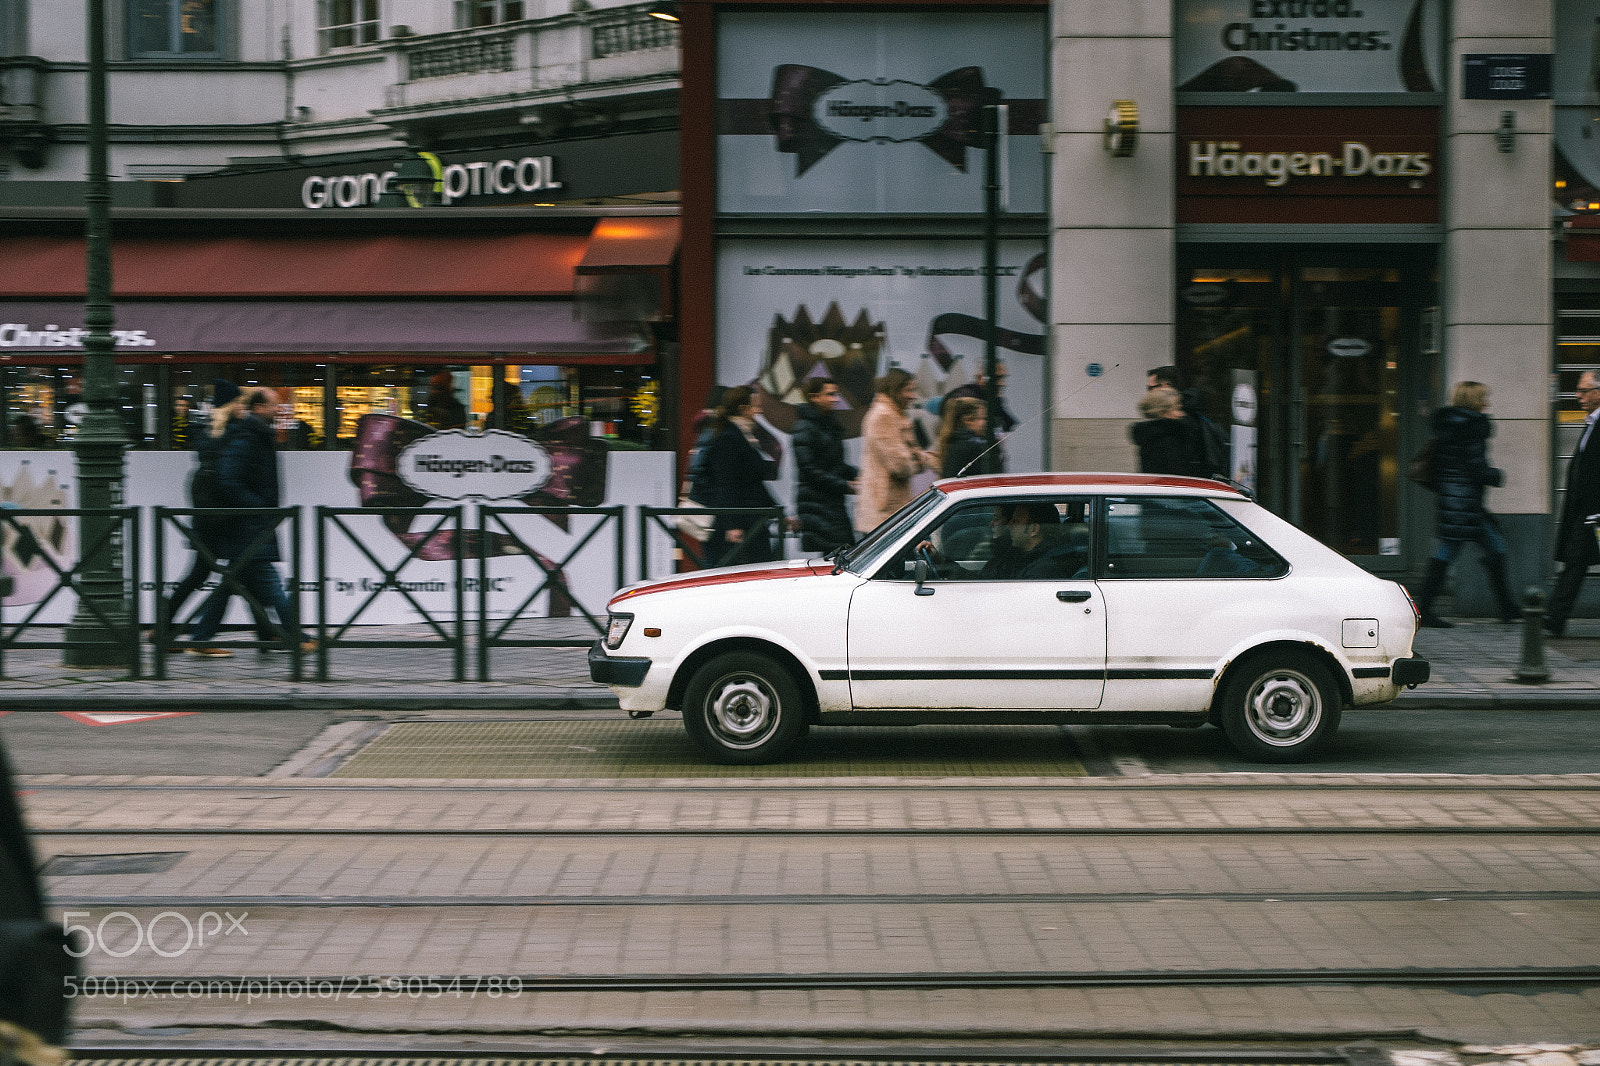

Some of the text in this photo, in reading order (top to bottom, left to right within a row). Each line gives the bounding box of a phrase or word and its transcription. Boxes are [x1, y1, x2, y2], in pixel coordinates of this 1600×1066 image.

[1221, 22, 1392, 51] Christmas.
[1189, 141, 1432, 187] Häagen-Dazs
[0, 324, 156, 347] Christas.
